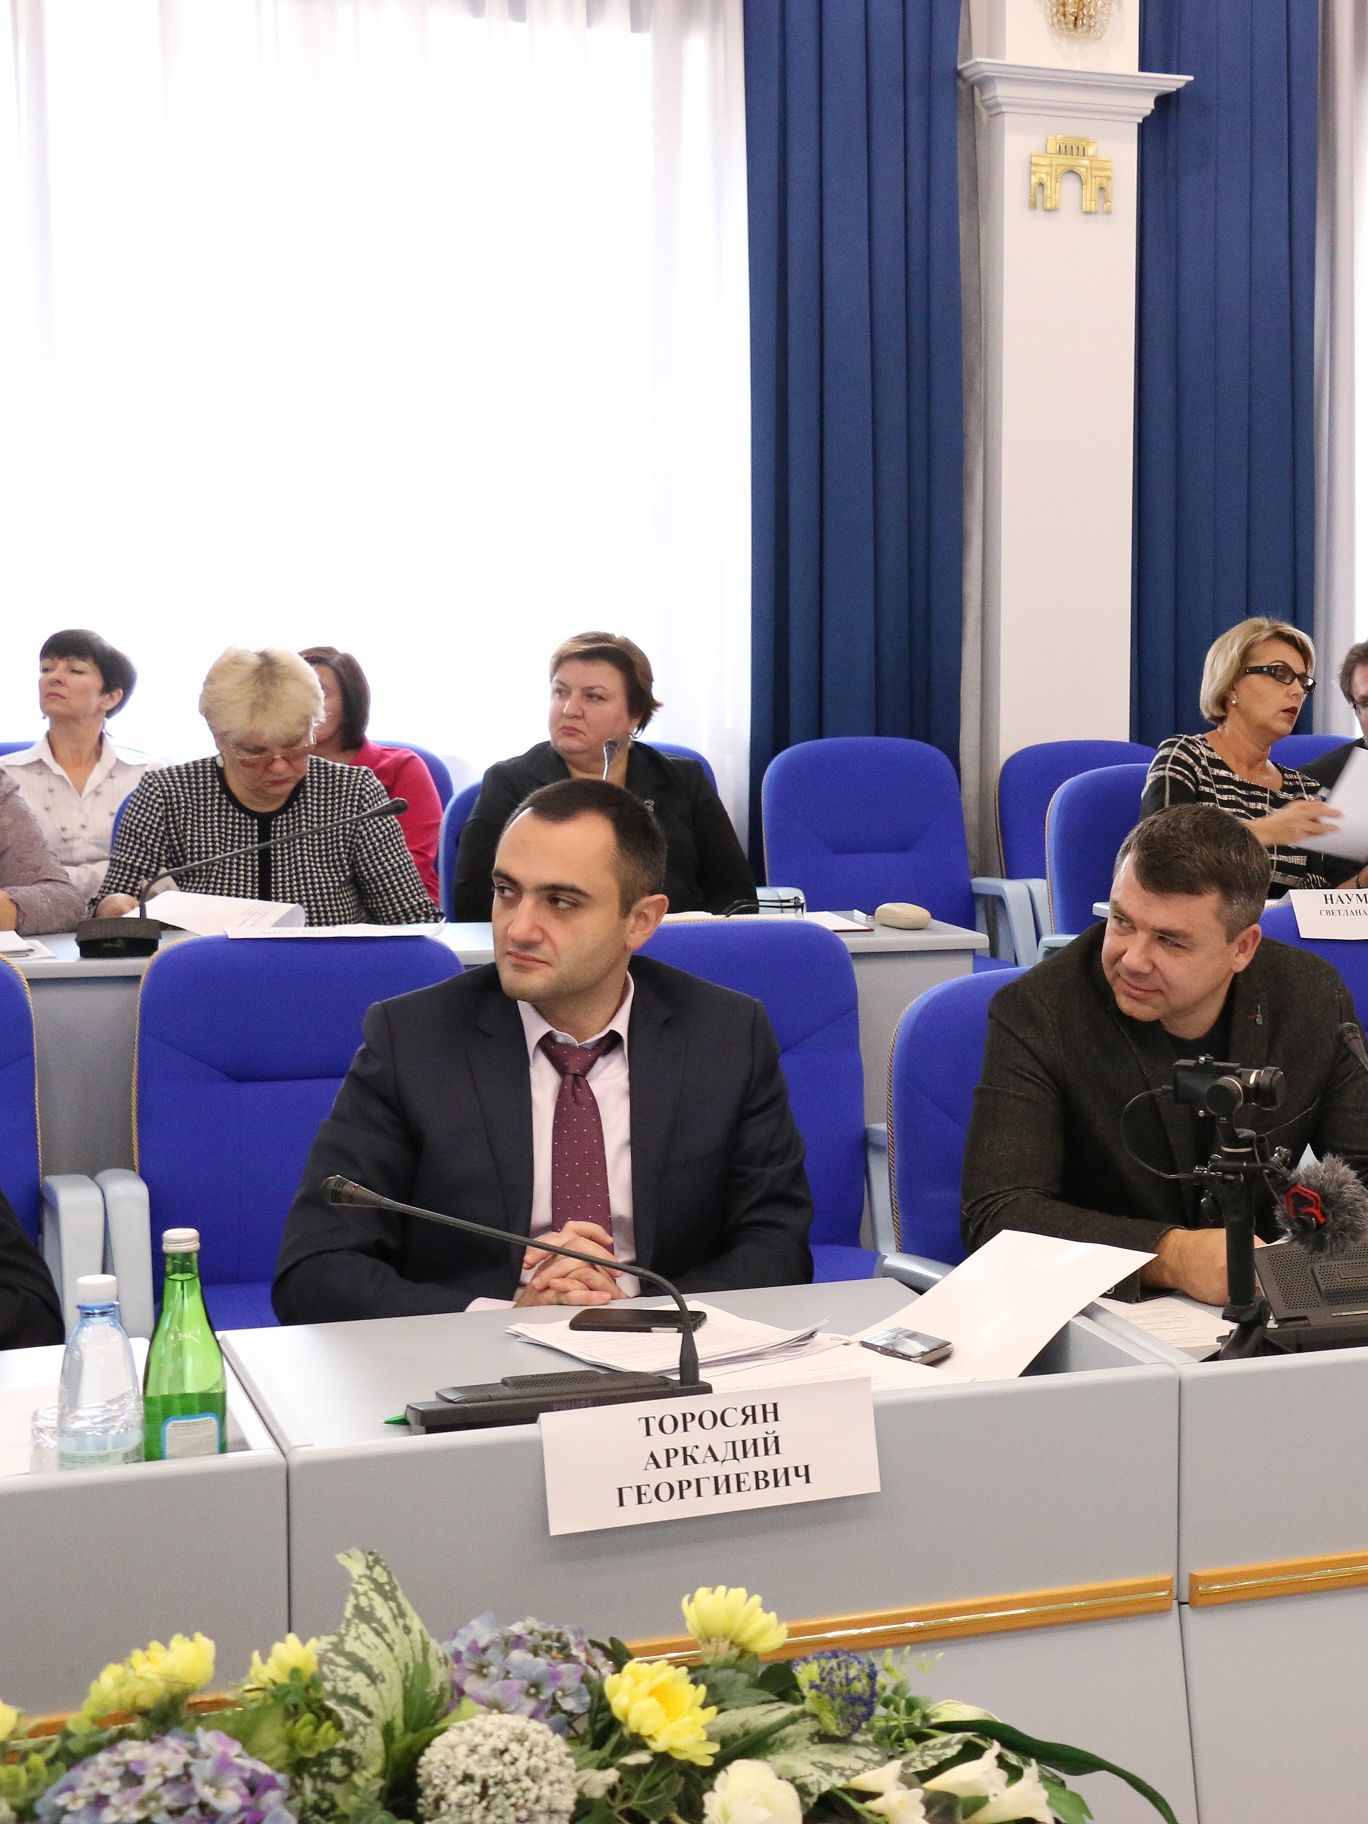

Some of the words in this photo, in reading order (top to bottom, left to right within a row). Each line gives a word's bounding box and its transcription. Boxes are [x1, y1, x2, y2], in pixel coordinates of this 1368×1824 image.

[1318, 908, 1367, 917] СВЕТЛАНА
[639, 1402, 781, 1437] ТОРОСЯН
[643, 1431, 783, 1471] АРКАДИЙ
[617, 1464, 814, 1507] ГЕОРГИЕВИЧ
